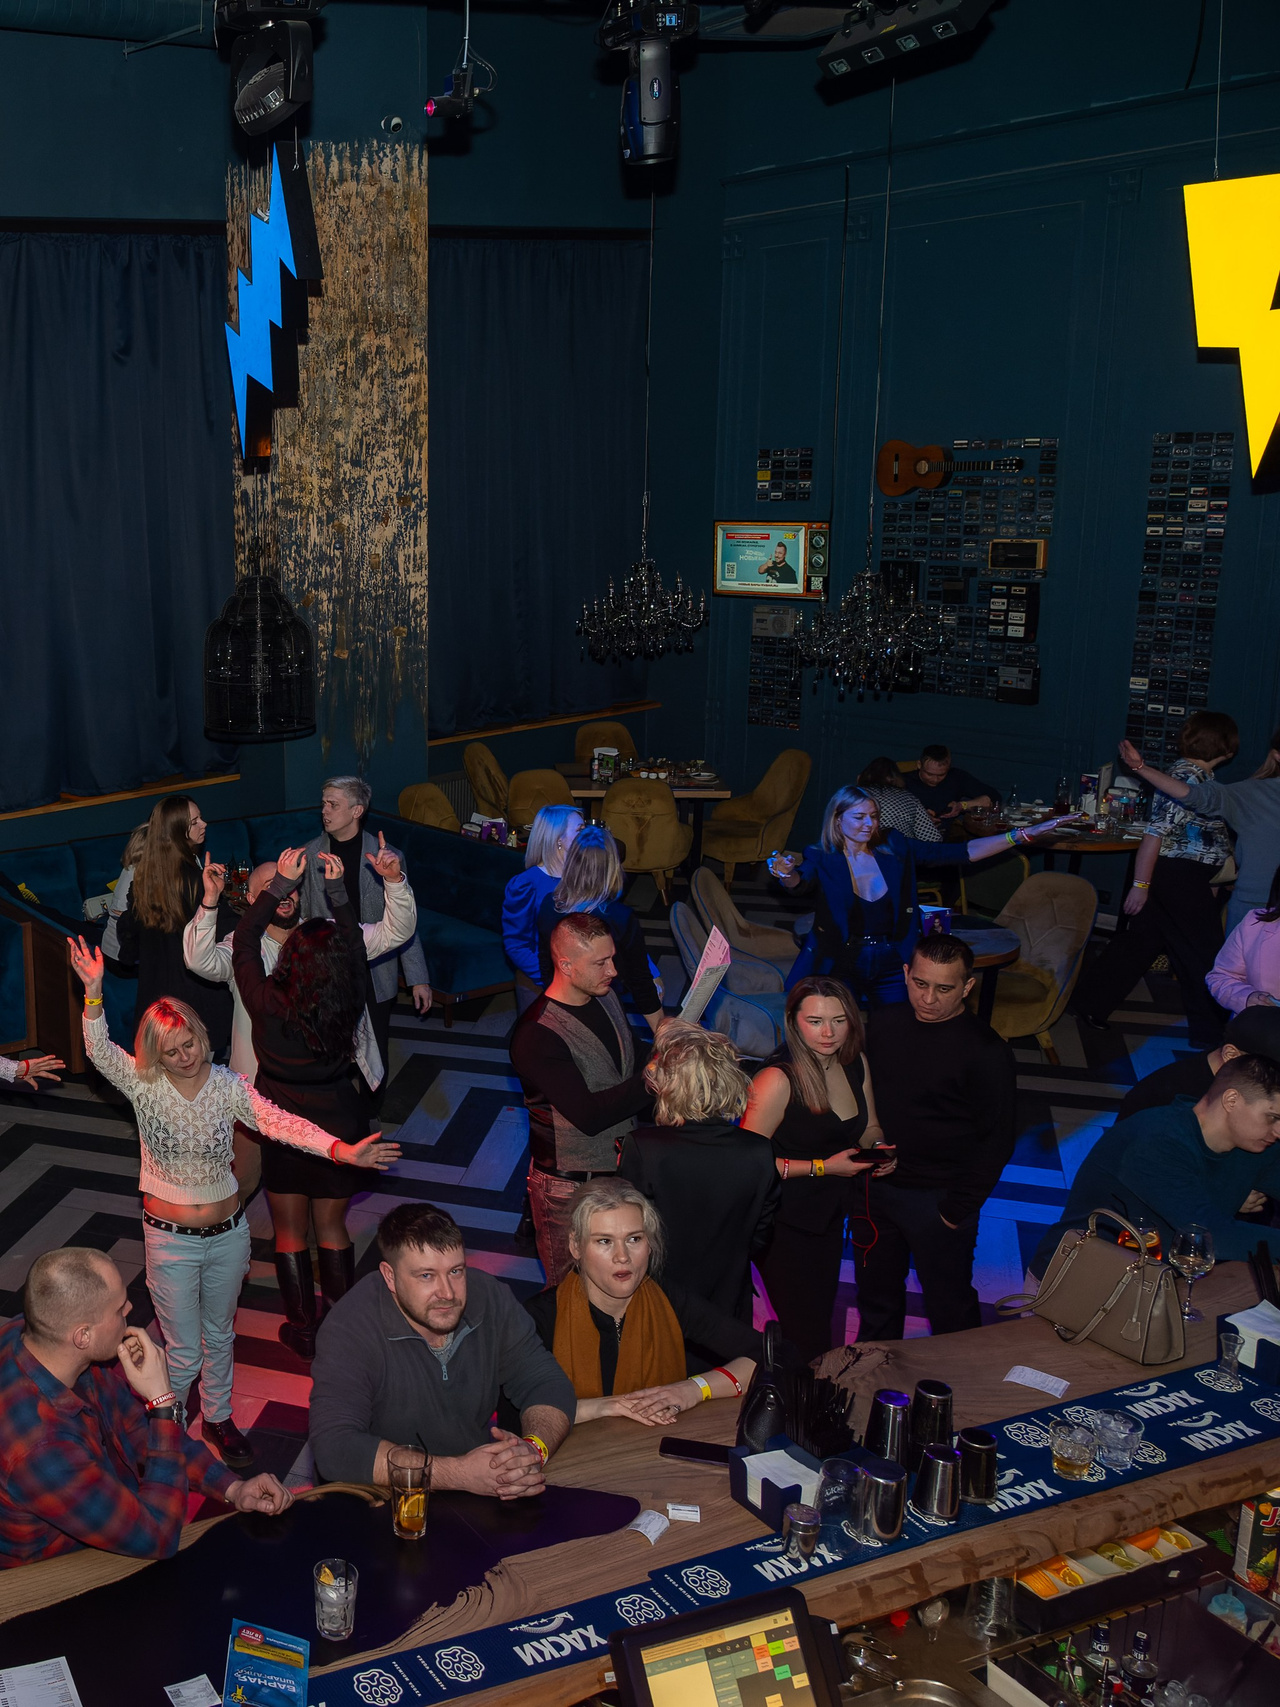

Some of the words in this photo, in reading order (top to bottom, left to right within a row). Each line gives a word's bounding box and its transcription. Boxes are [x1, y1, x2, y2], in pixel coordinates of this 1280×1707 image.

[1125, 1390, 1205, 1420] ХАСКИ
[1180, 1420, 1263, 1452] ХАСКИ
[512, 1624, 608, 1666] ХАСКИ
[237, 1669, 295, 1684] ШПАРГАЛКА
[238, 1676, 296, 1693] БАРНАЯ
